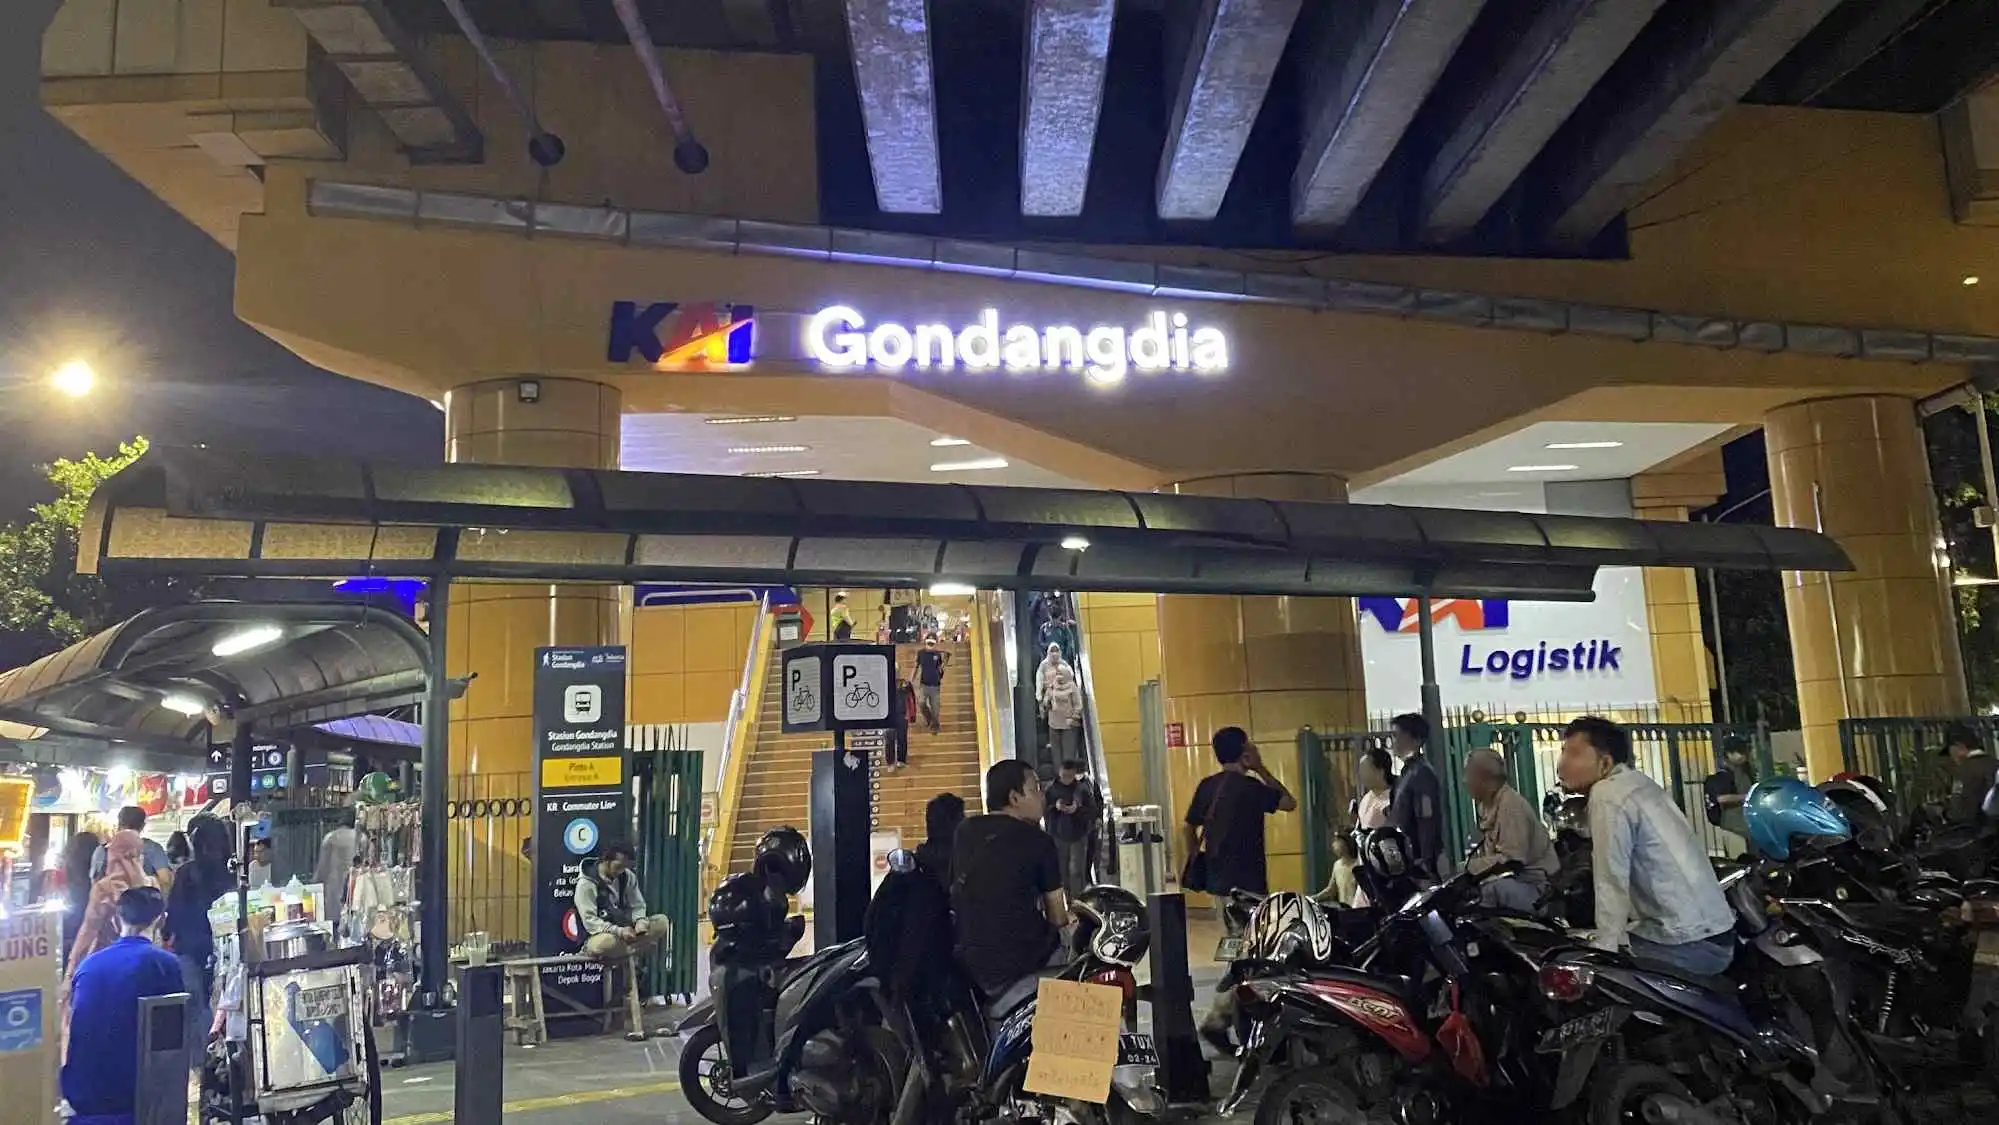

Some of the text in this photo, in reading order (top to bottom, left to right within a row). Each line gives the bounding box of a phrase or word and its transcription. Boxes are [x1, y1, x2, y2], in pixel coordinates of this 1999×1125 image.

[608, 301, 1228, 383] KAI Gondangdia
[1460, 639, 1621, 679] Logistik
[792, 669, 801, 692] P
[842, 665, 857, 688] P
[548, 730, 618, 741] Stasiun Gondangdia
[551, 741, 614, 753] Gondangdia Station
[562, 801, 599, 812] Commuter
[600, 800, 616, 810] Line
[578, 827, 586, 842] C
